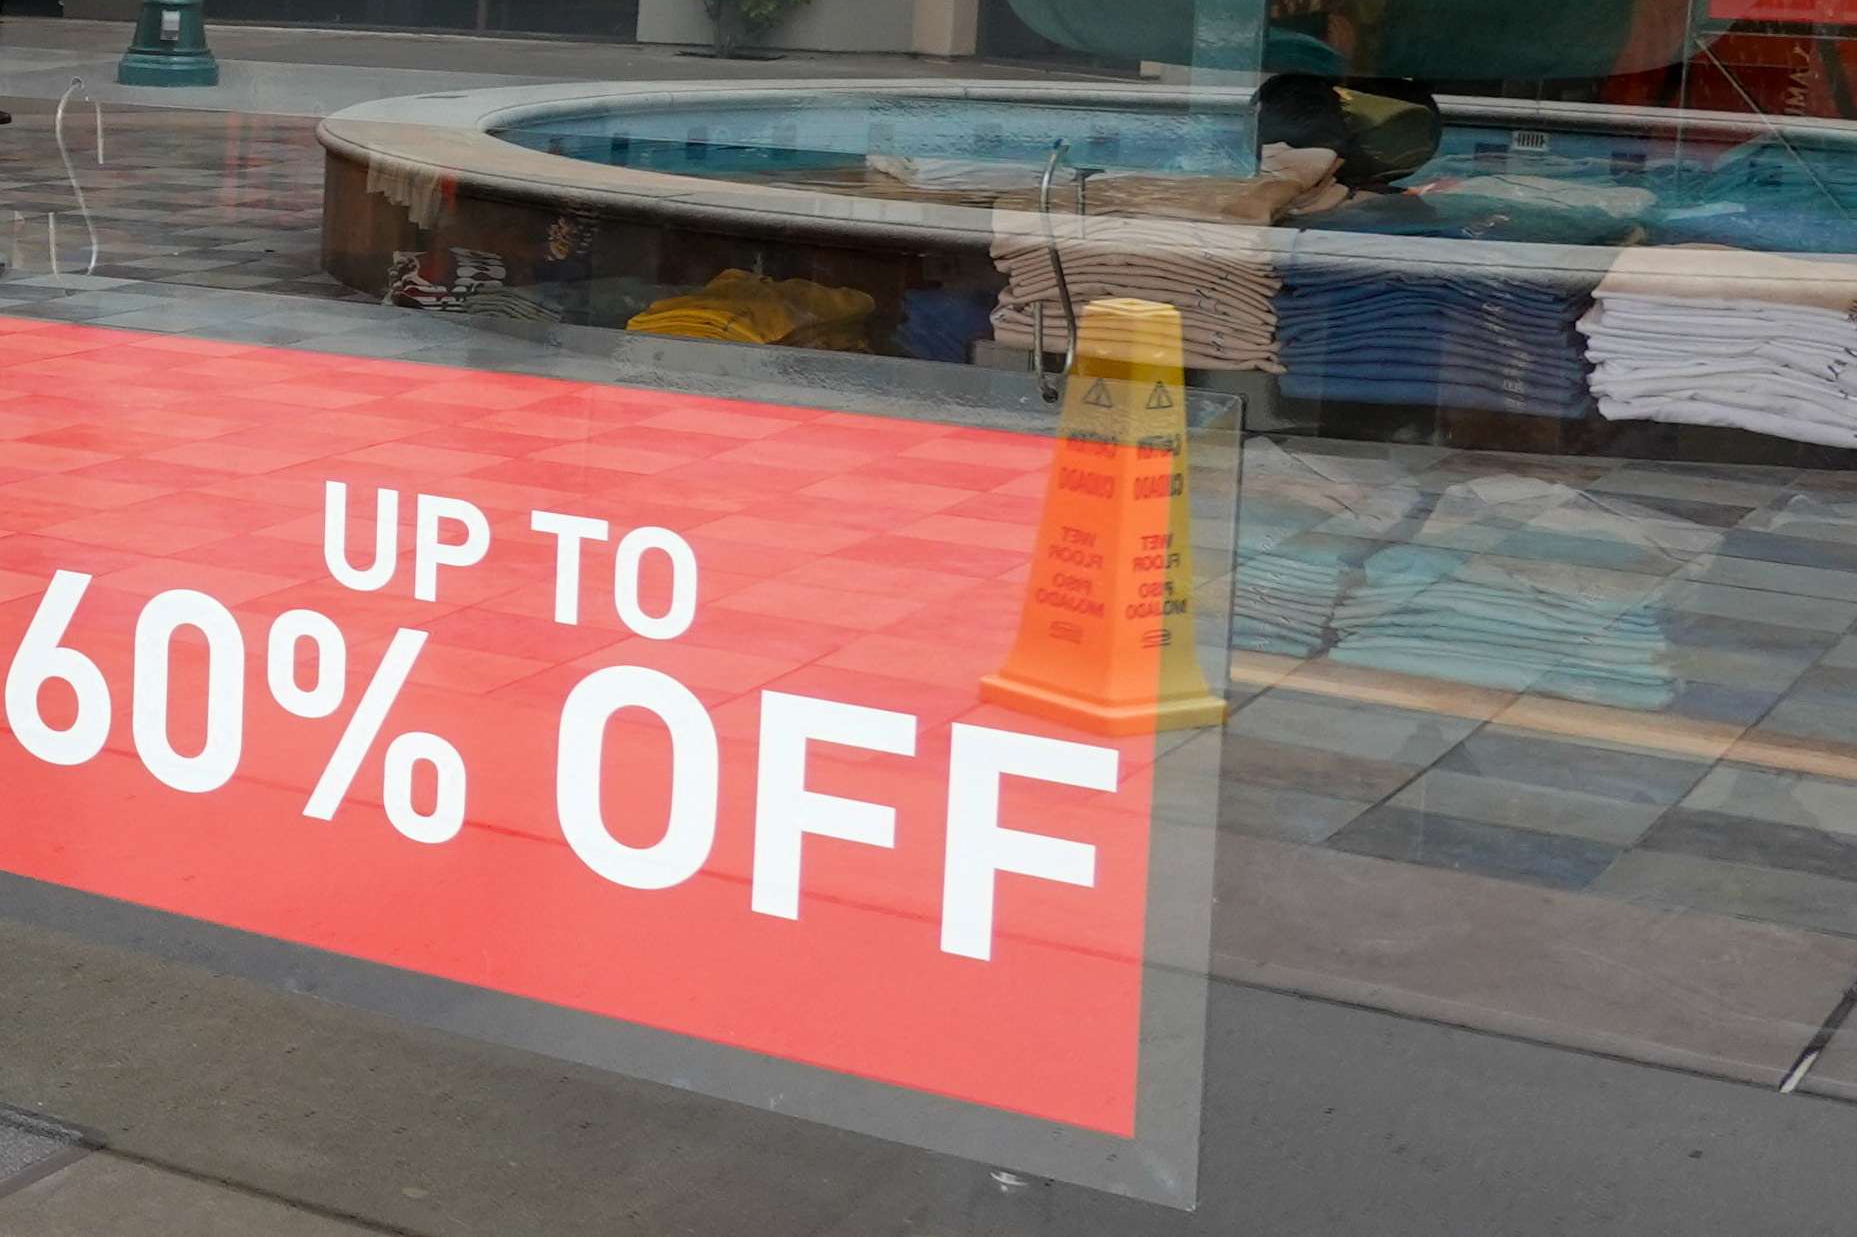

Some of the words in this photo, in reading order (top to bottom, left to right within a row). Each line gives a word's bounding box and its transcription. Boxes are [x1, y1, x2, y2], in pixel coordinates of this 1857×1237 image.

[321, 479, 491, 602] UP
[529, 508, 700, 641] TO
[3, 568, 468, 846] 60%
[555, 664, 1121, 962] OFF
